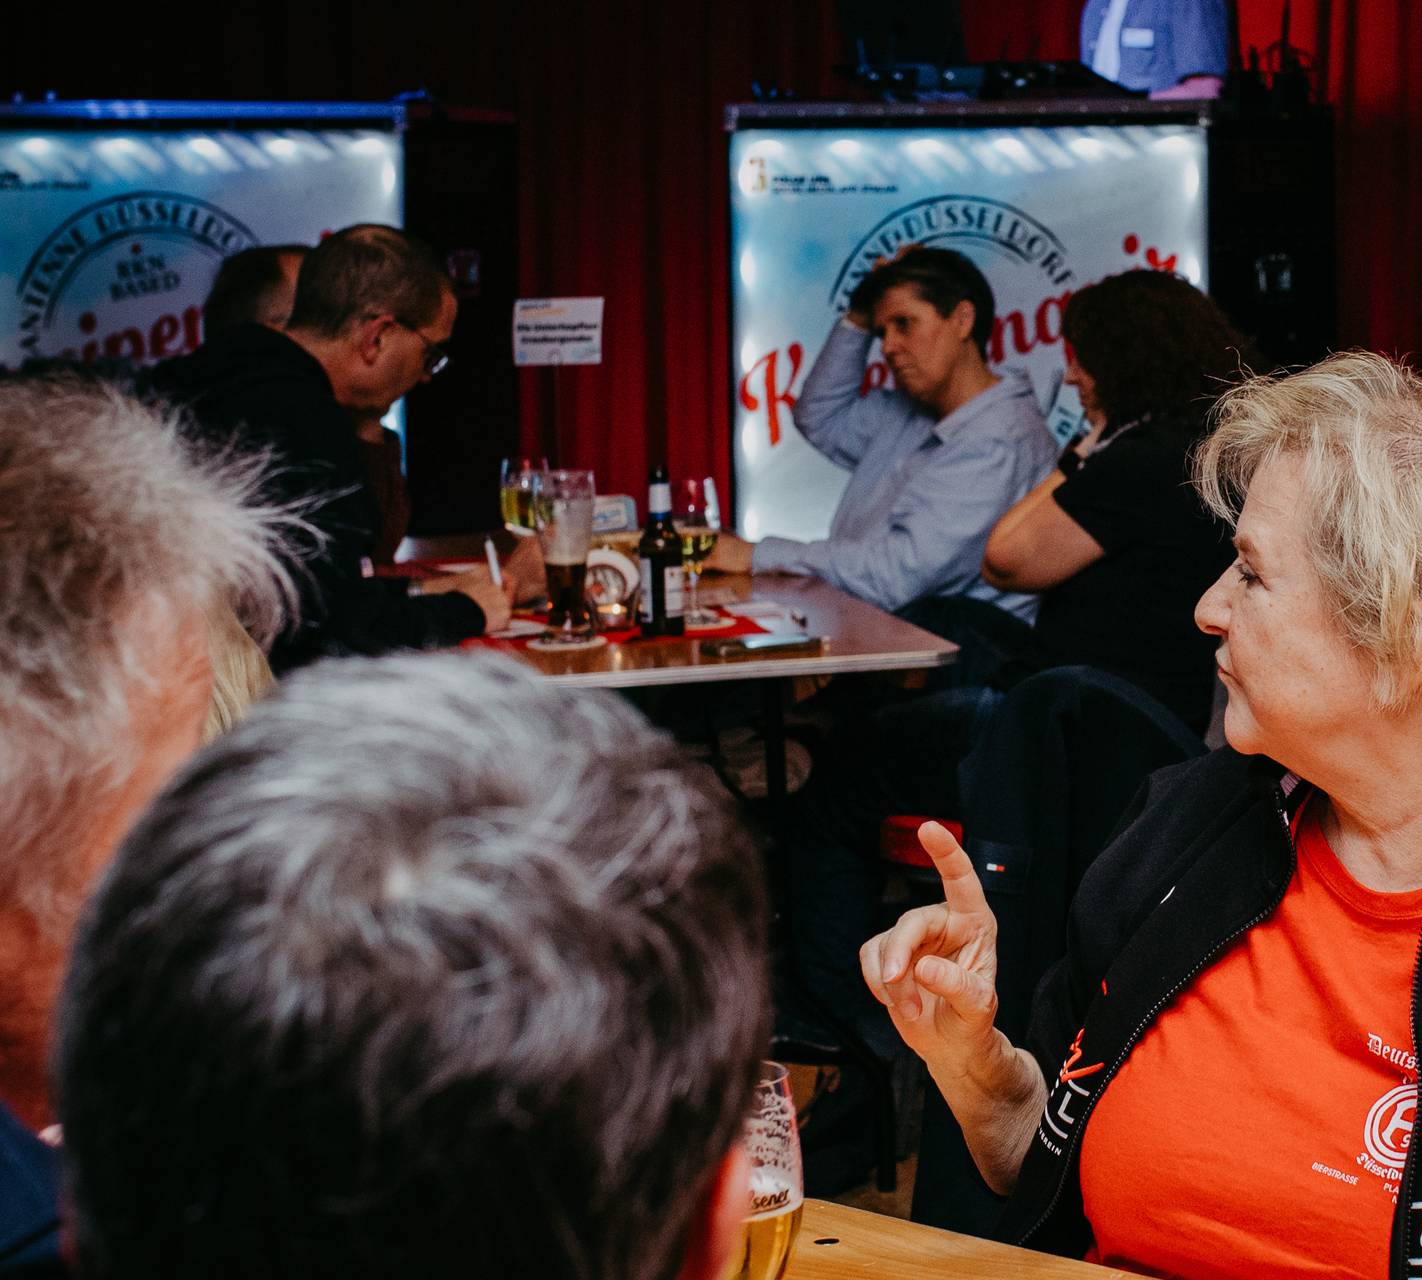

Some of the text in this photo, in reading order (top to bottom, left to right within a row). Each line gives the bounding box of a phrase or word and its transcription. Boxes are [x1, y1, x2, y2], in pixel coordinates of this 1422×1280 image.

[95, 200, 246, 252] DÜSSELDO
[1367, 1032, 1417, 1070] Deuts
[1383, 1182, 1399, 1195] PLA
